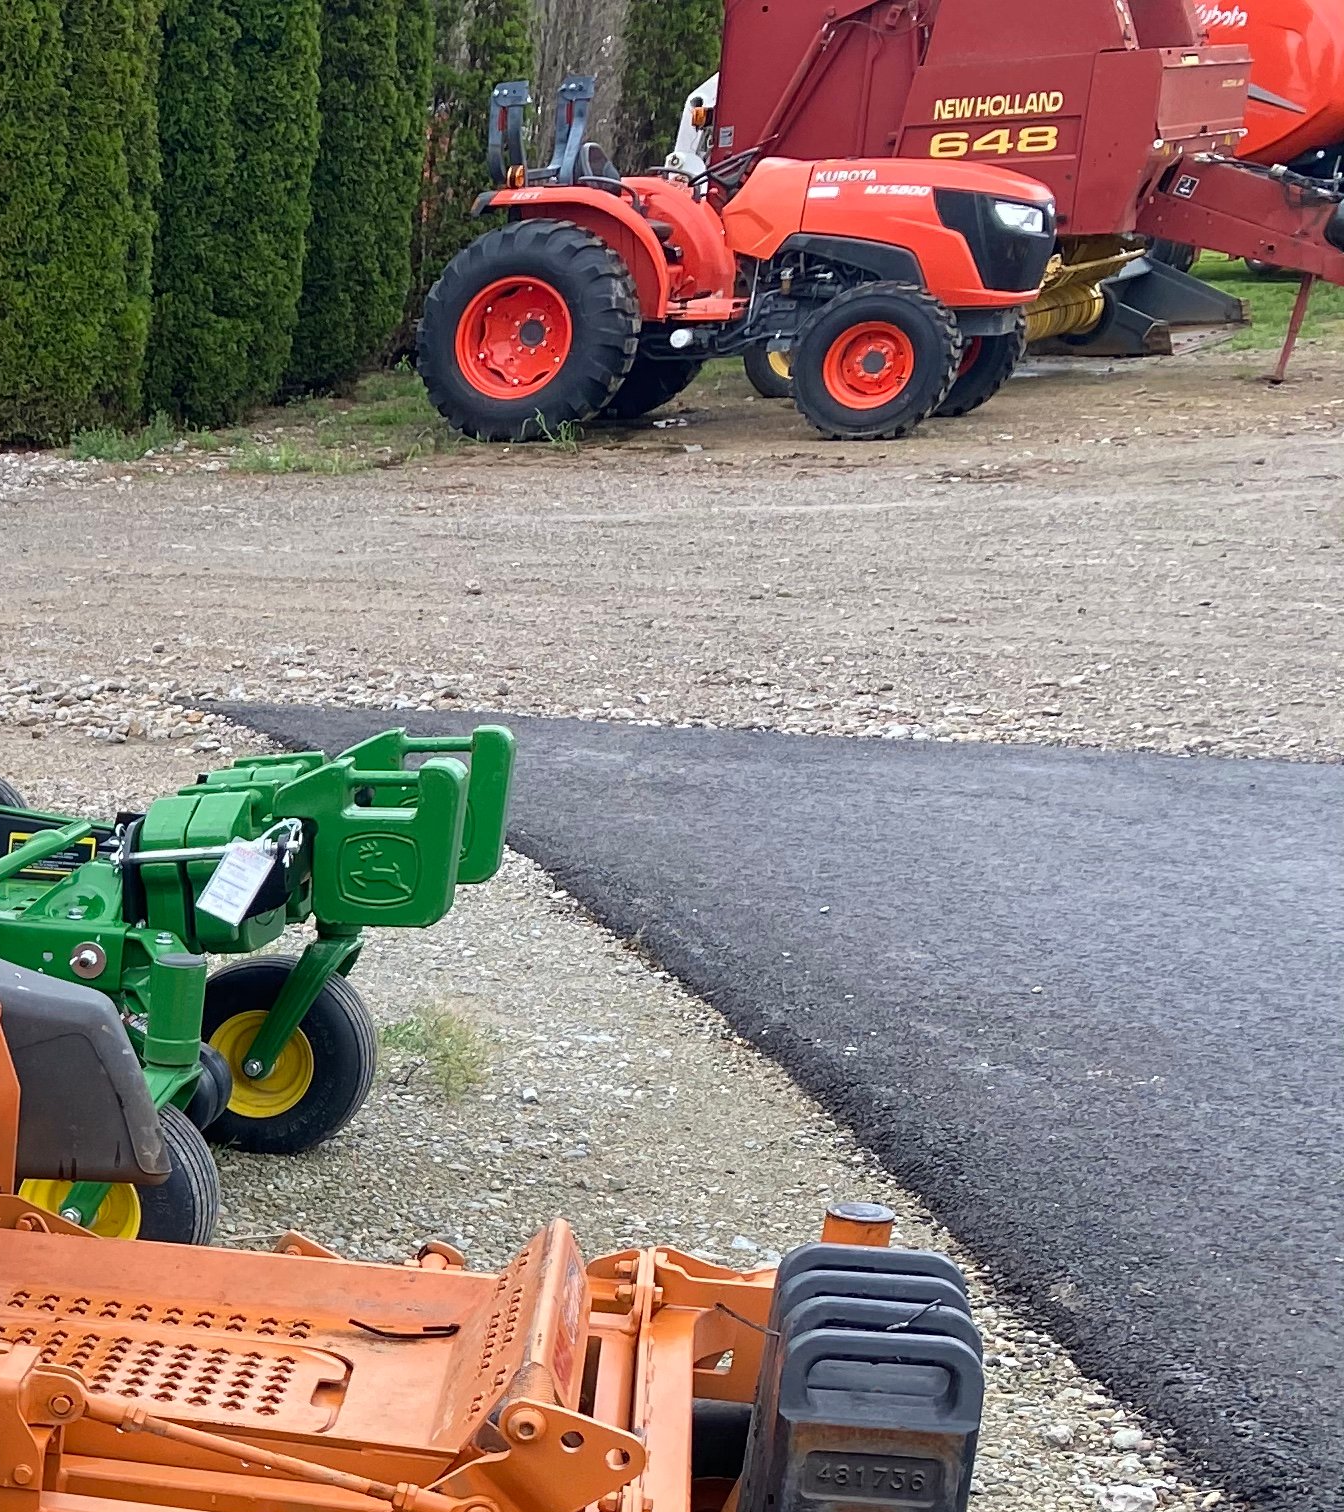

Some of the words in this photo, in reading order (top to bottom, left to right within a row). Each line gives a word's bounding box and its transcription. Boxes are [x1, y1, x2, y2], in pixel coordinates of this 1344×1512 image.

[933, 97, 975, 121] NEW
[975, 91, 1064, 117] HOLLAND
[929, 125, 1059, 158] 648
[815, 168, 878, 184] KUBOTA
[863, 184, 932, 197] MX5800
